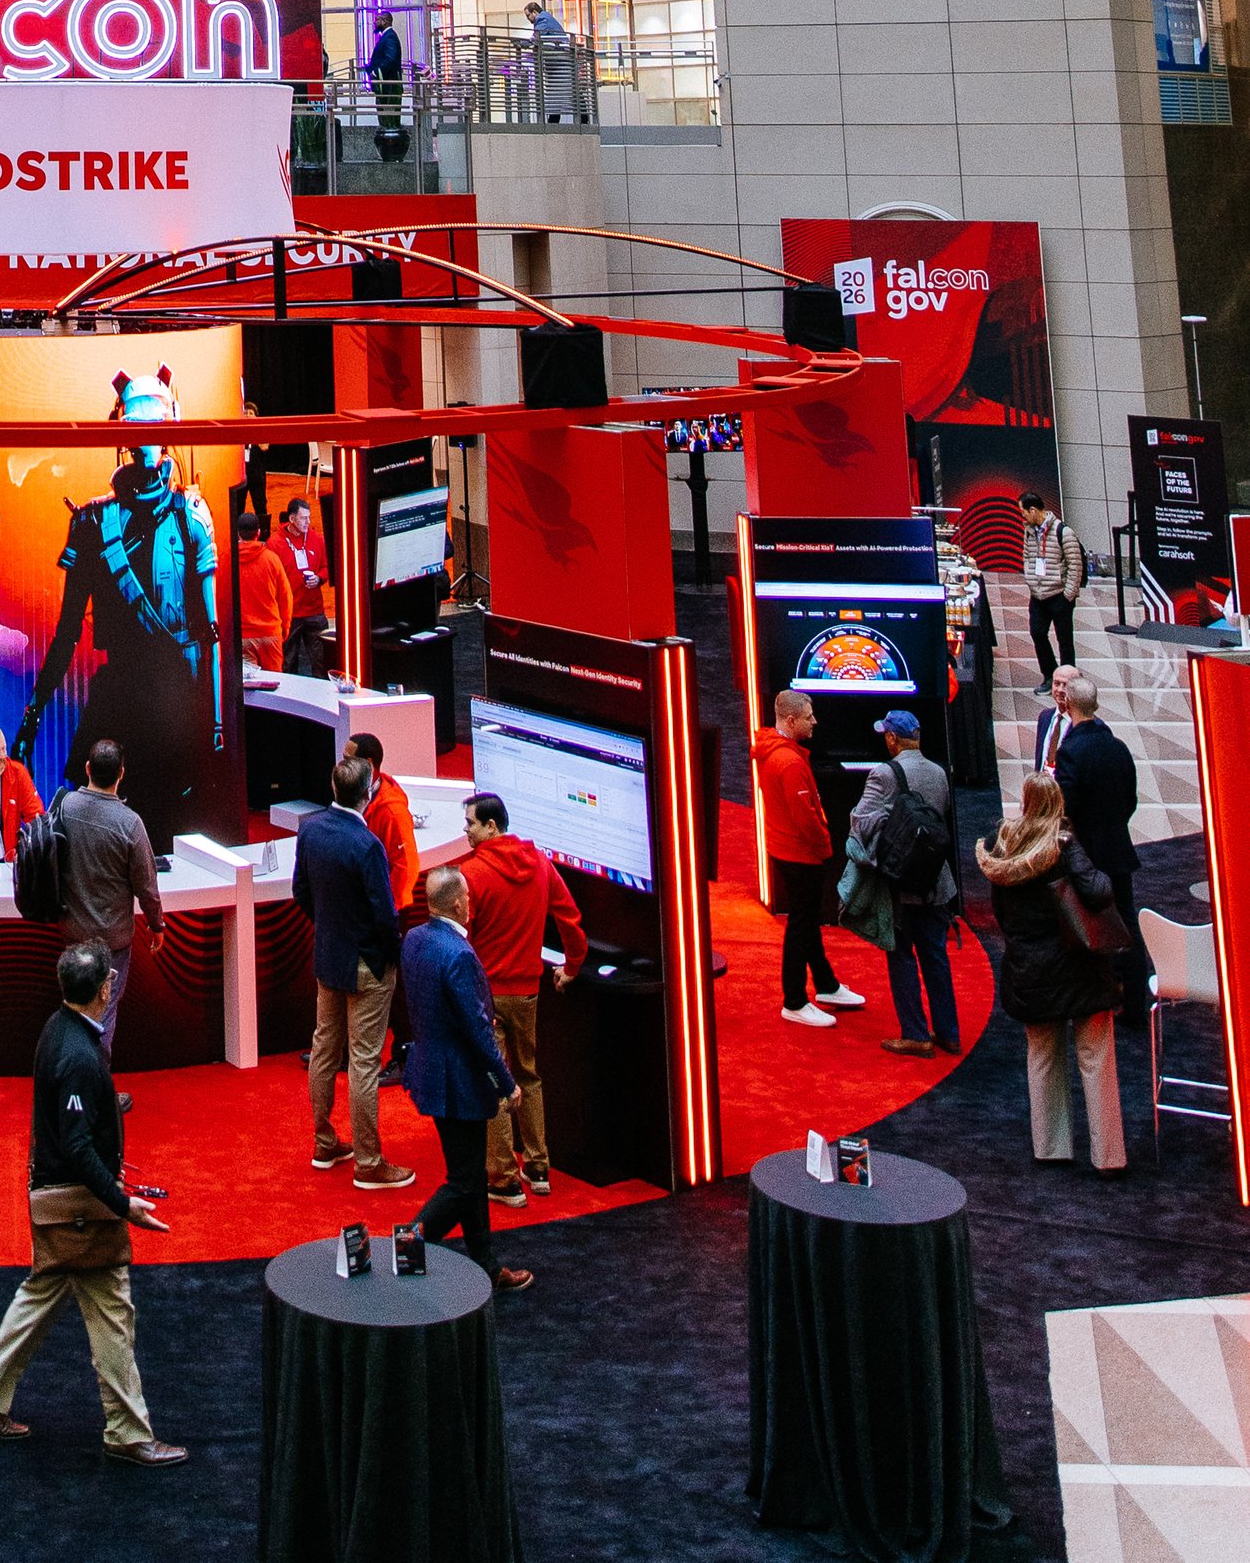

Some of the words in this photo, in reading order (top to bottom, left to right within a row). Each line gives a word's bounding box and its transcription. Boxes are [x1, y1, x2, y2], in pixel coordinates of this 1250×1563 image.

[841, 271, 865, 287] 20
[883, 259, 990, 290] fal.con
[842, 288, 866, 305] 26
[886, 289, 949, 320] gov
[1166, 486, 1192, 494] FUTURE
[1177, 479, 1190, 487] THE
[776, 543, 821, 551] Mission-Critical
[1158, 549, 1196, 561] carahsoft
[489, 648, 508, 659] Secure
[515, 653, 540, 666] Identities
[540, 659, 551, 669] with
[551, 662, 570, 673] Falcon
[570, 665, 596, 679] Next-Gen
[596, 670, 617, 685] Identity
[617, 675, 641, 690] Security
